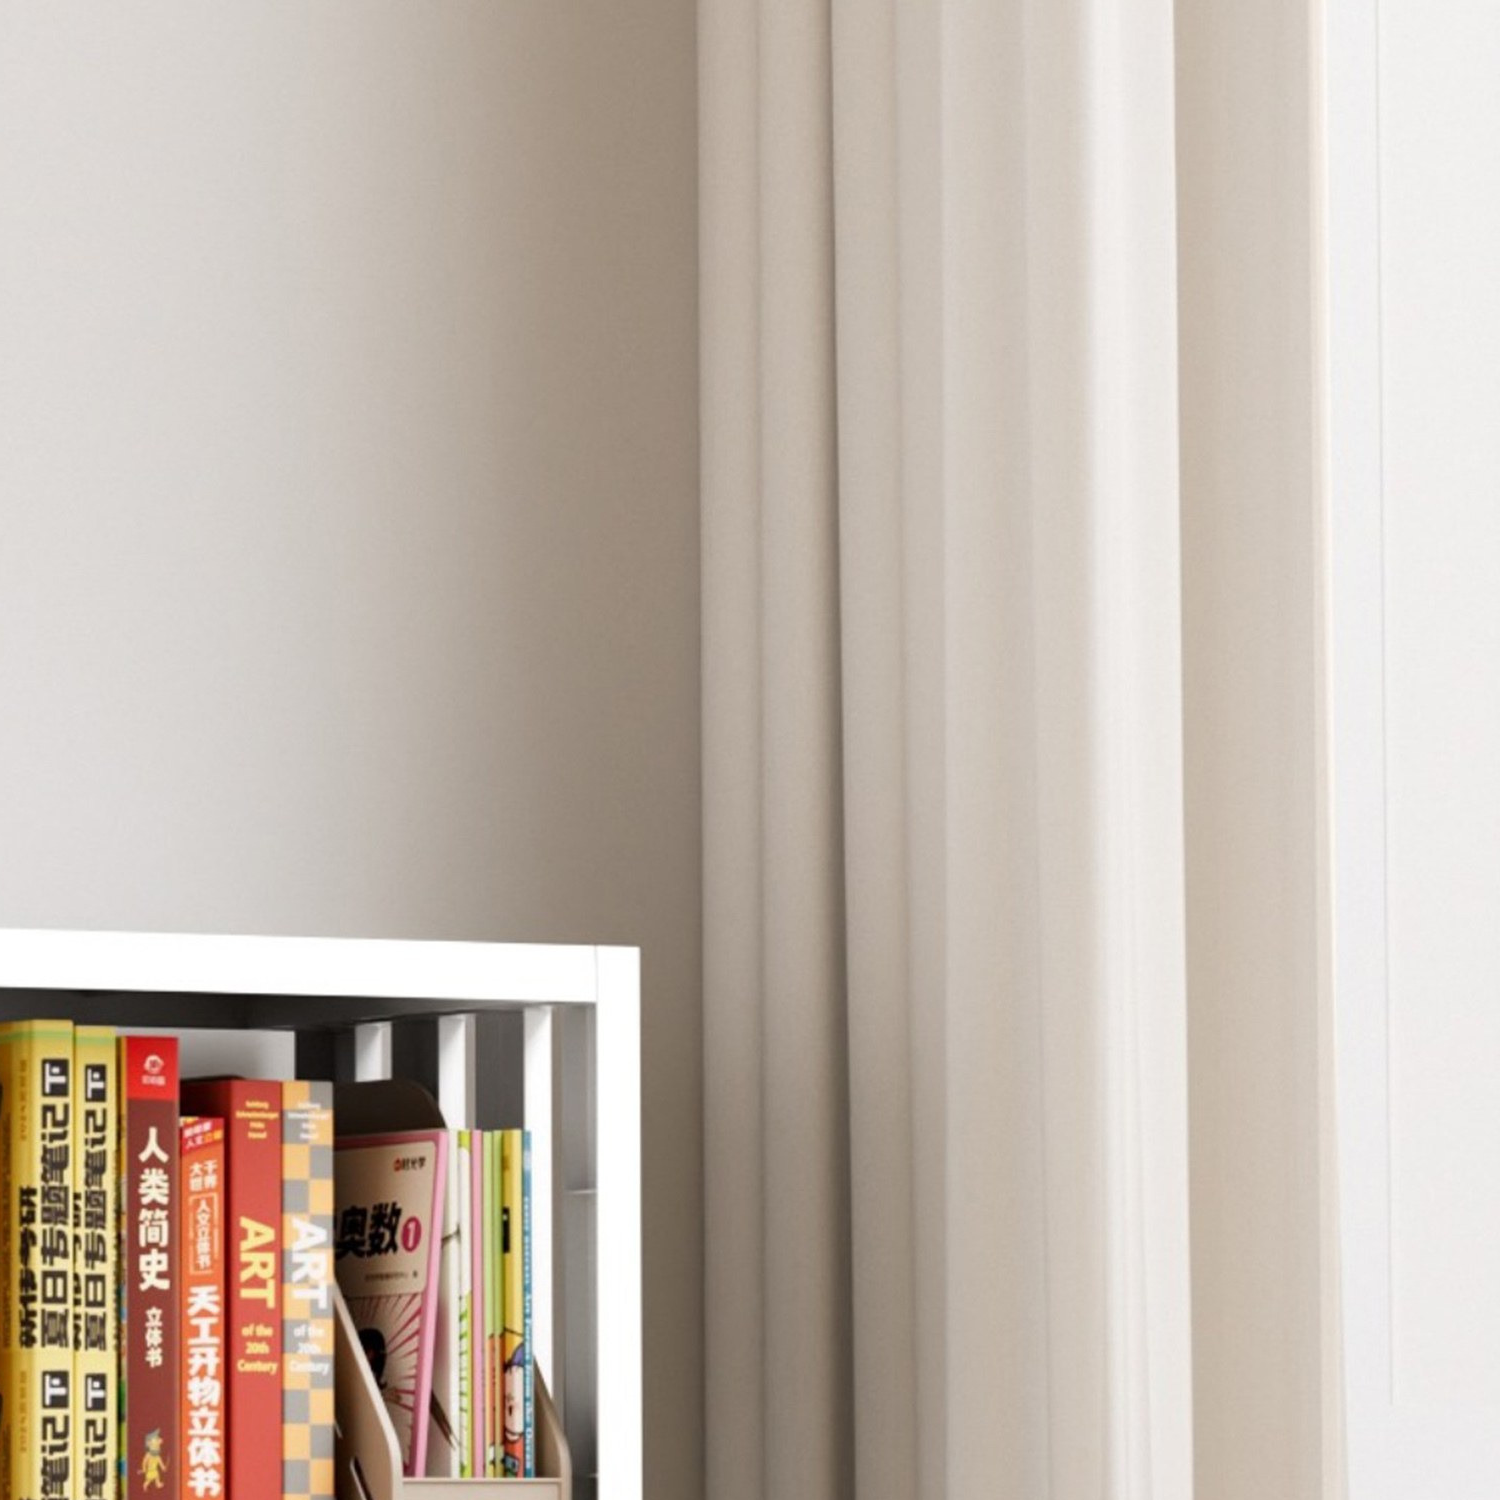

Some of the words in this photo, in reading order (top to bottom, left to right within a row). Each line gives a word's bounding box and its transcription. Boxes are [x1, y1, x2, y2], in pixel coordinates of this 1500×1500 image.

[41, 1103, 69, 1348] 夏日专题笔记
[85, 1107, 107, 1350] 夏日专题笔记
[138, 1126, 170, 1292] 人类简史
[240, 1216, 275, 1309] ART
[292, 1217, 327, 1309] ART
[145, 1307, 163, 1368] 立体书
[237, 1359, 278, 1376] Century
[241, 1323, 255, 1337] of
[256, 1323, 274, 1337] the
[187, 1285, 221, 1498] 天工开物立体书
